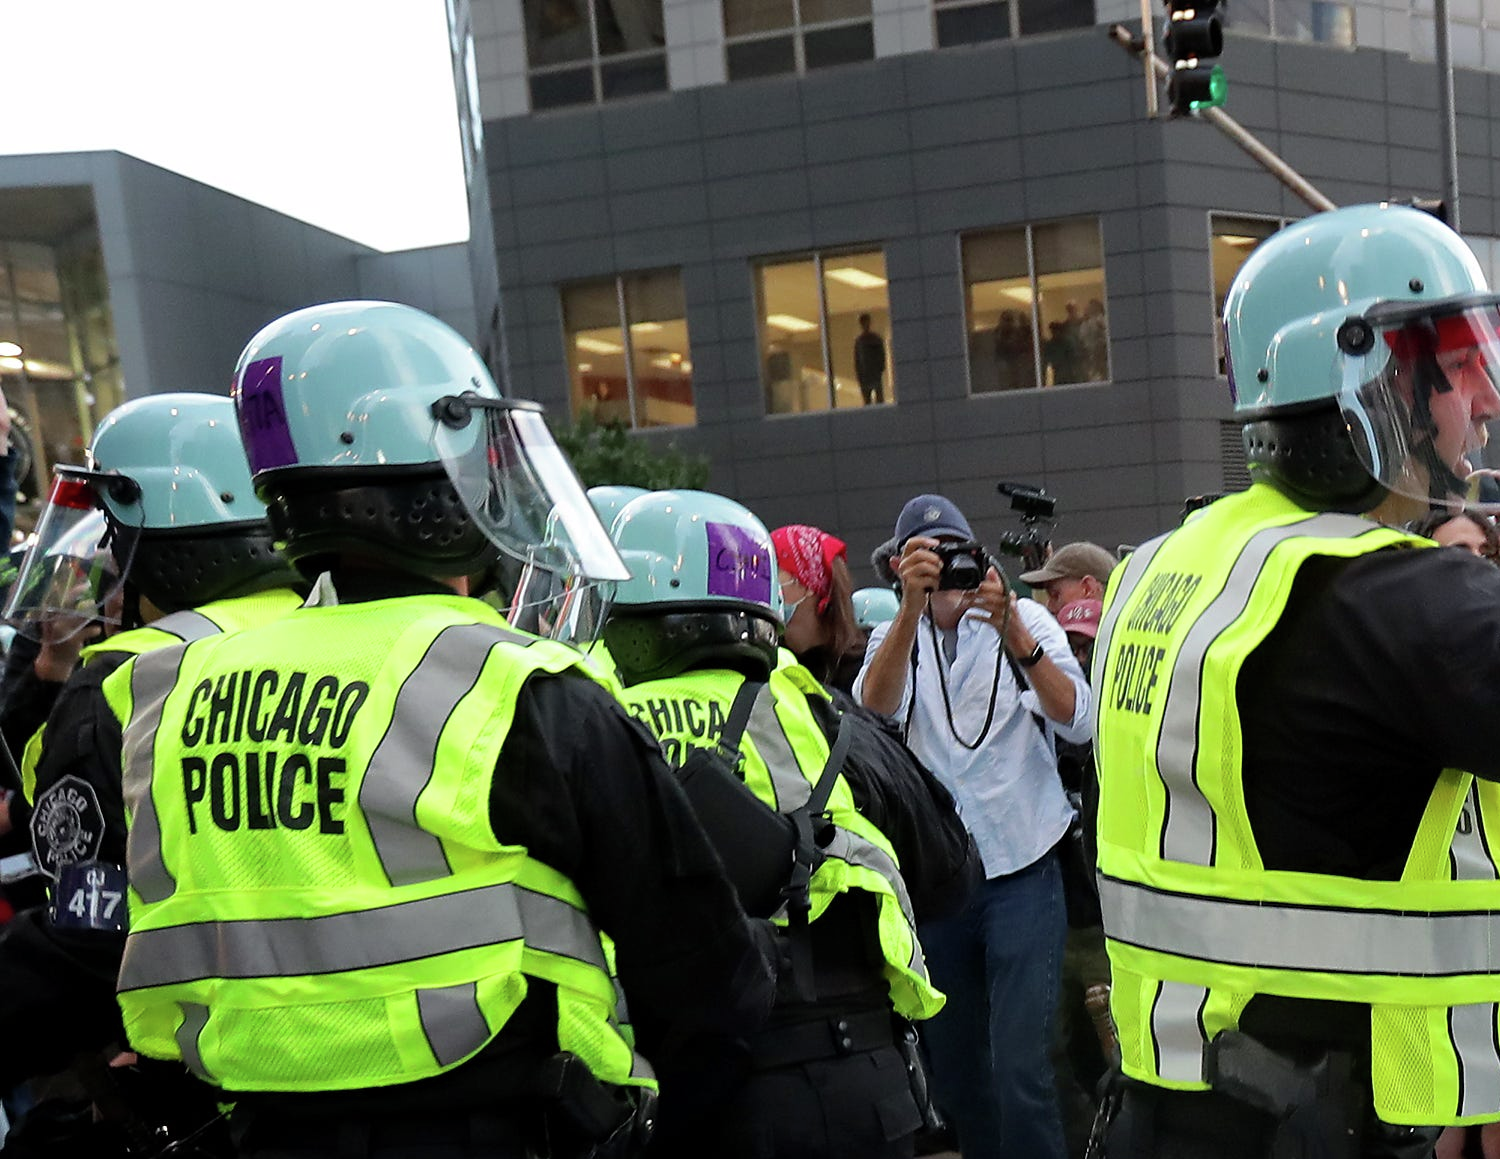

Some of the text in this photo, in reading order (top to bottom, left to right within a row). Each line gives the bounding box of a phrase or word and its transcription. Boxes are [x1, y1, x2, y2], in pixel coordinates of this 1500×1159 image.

[1126, 574, 1202, 633] CHICAGO
[1108, 642, 1165, 716] POLICE
[181, 667, 368, 751] CHICAGO
[629, 696, 726, 741] CHICA
[38, 787, 89, 838] CHICAGO
[180, 751, 347, 835] POLICE
[46, 829, 93, 866] POLICE
[68, 887, 122, 920] 417
